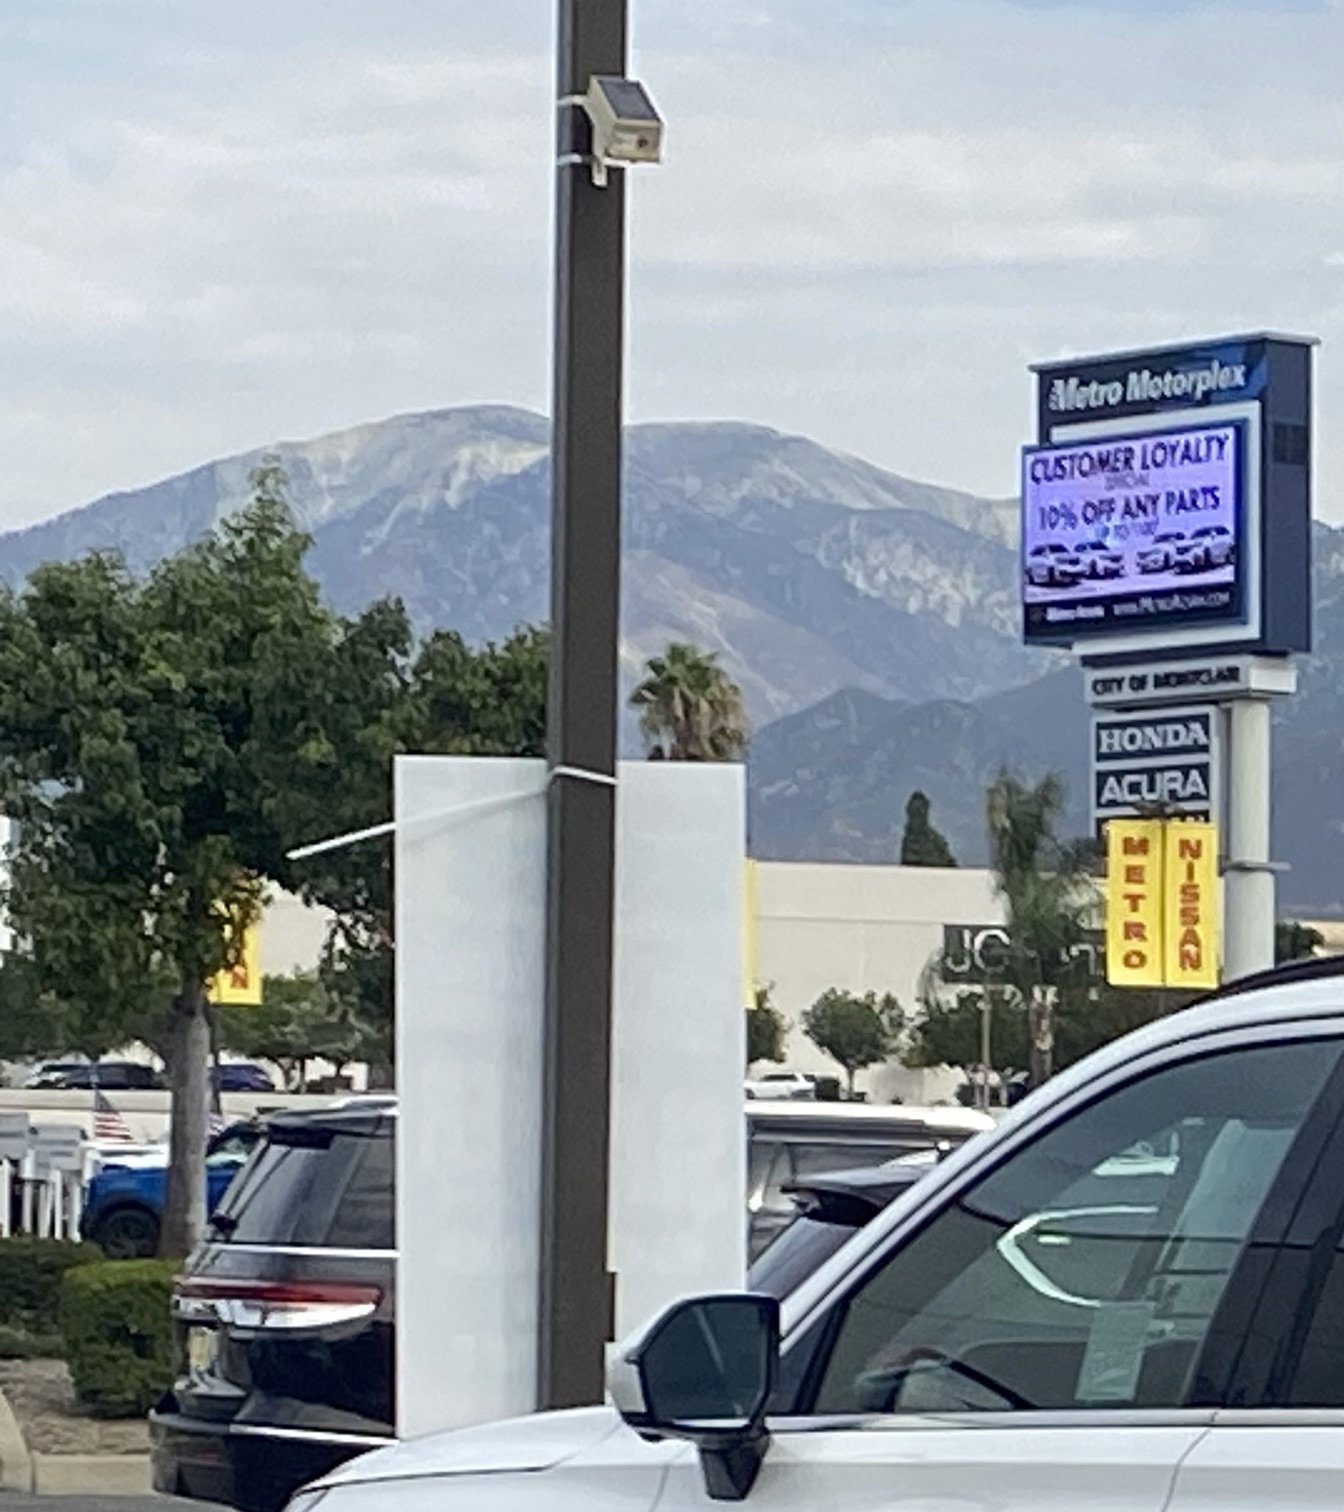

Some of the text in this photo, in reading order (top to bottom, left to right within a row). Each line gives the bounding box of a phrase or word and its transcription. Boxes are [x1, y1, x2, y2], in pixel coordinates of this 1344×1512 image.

[1052, 360, 1246, 411] Metro Motorplex
[1031, 433, 1230, 484] CUSTOMER LOYALTY
[1039, 485, 1220, 530] 10% OFF ANY PARTS
[1091, 666, 1241, 695] CITY OF MONTCLAIR
[1099, 721, 1210, 754] HONDA
[1100, 769, 1207, 804] ACURA
[1121, 836, 1150, 969] METRO
[1178, 839, 1202, 971] NISSAN
